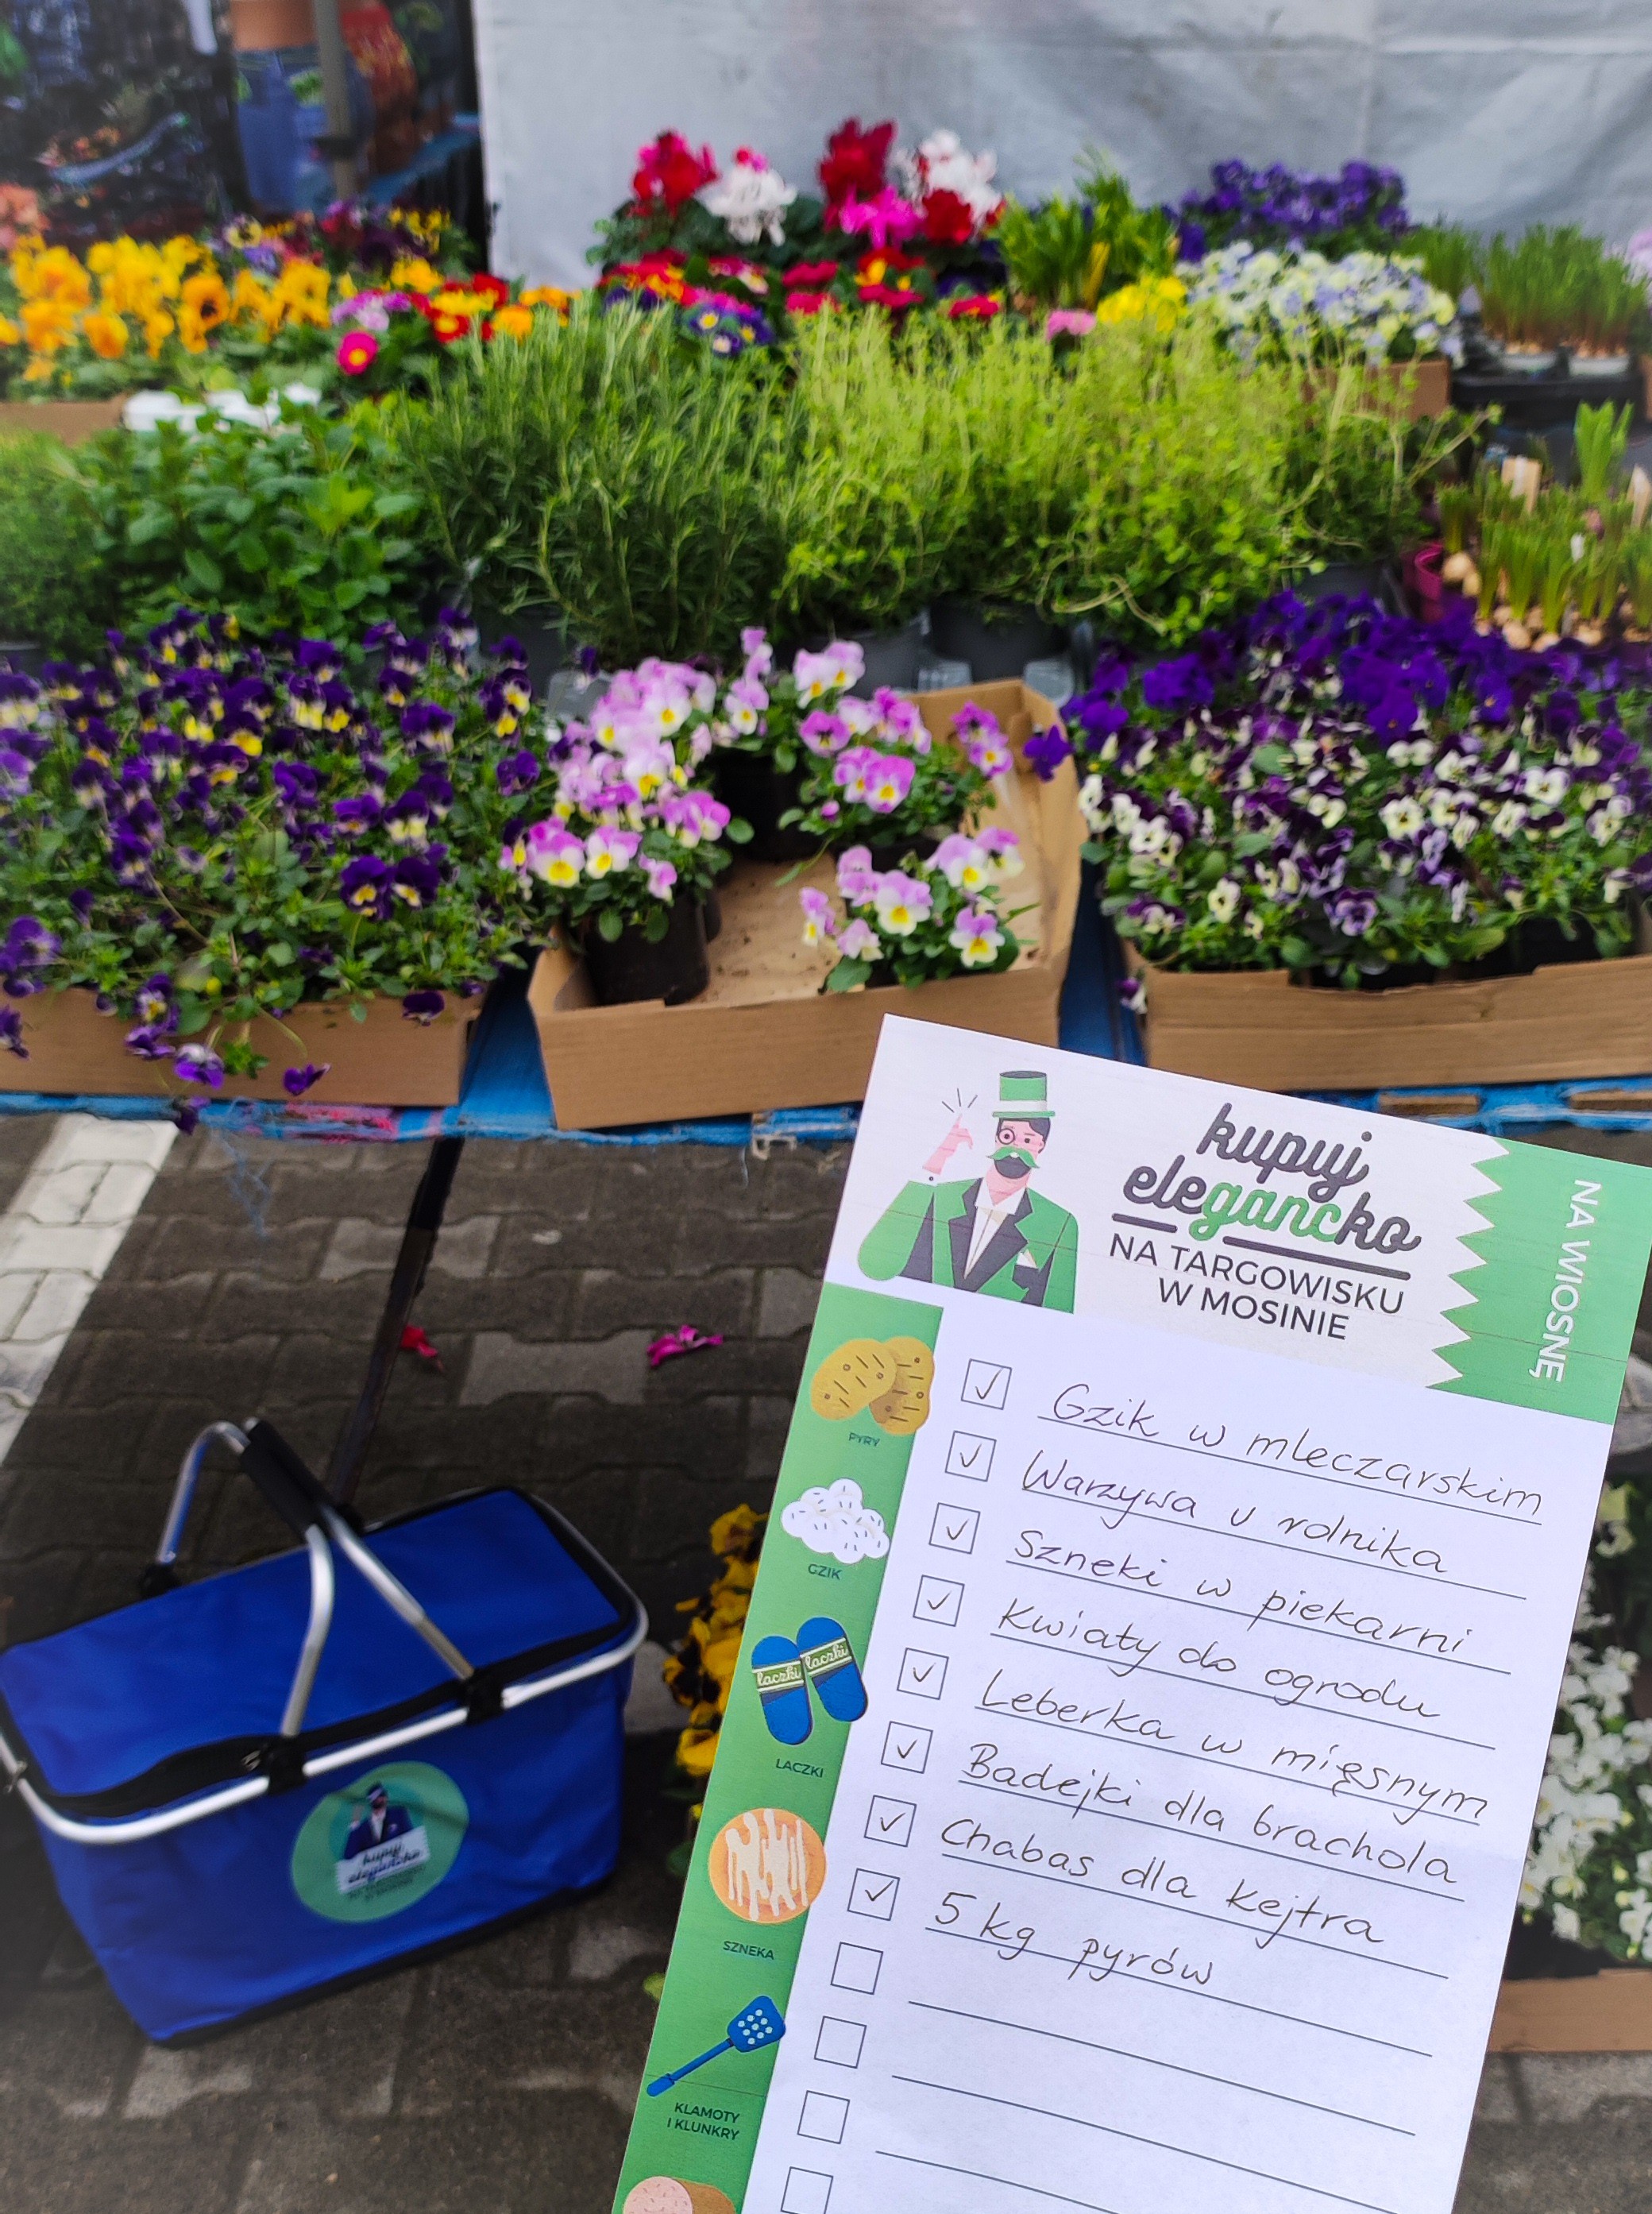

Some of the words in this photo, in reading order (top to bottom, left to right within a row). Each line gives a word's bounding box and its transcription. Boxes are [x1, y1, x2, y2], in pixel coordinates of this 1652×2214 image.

[1196, 1103, 1368, 1204] kupuj
[1123, 1154, 1421, 1254] elegancko
[1569, 1179, 1601, 1230] NA
[1110, 1232, 1158, 1266] NA
[1170, 1246, 1404, 1314] TARGOWISKU
[1159, 1277, 1194, 1308] W
[1200, 1291, 1349, 1339] MOSINIE
[1530, 1240, 1590, 1381] WIOSNĘ
[848, 1432, 880, 1447] PYRY
[1053, 1384, 1160, 1438] Gzik
[1190, 1424, 1226, 1447] w
[1246, 1428, 1542, 1515] mleczarskim
[1021, 1450, 1198, 1528] Warzywa
[1277, 1514, 1448, 1573] rolnika
[808, 1563, 841, 1581] GZIK
[1013, 1530, 1164, 1586] Szneki
[1197, 1577, 1233, 1597] w
[1249, 1590, 1473, 1652] piekarni
[757, 1666, 801, 1687] laczki
[805, 1644, 849, 1670] laczki
[998, 1599, 1161, 1676] Kwiaty
[1179, 1642, 1236, 1672] do
[1264, 1664, 1441, 1718] ogrodu
[775, 1759, 824, 1778] LACZKI
[982, 1668, 1175, 1740] Leberka
[1201, 1734, 1243, 1754] w
[1272, 1745, 1488, 1823] mięsnym
[967, 1743, 1141, 1818] Badejki
[1164, 1790, 1224, 1833] dla
[1252, 1805, 1457, 1884] brachola
[941, 1818, 1095, 1878] Chabas
[1121, 1857, 1197, 1898] dla
[1226, 1879, 1384, 1949] kejtra
[723, 1940, 774, 1960] SZNEKA
[935, 1891, 977, 1926] 5
[979, 1903, 1036, 1960] kg
[1067, 1938, 1213, 1985] pyrów
[666, 2117, 672, 2128] I
[674, 2119, 740, 2141] KLUNKRY
[674, 2102, 740, 2123] KLAMOTY
